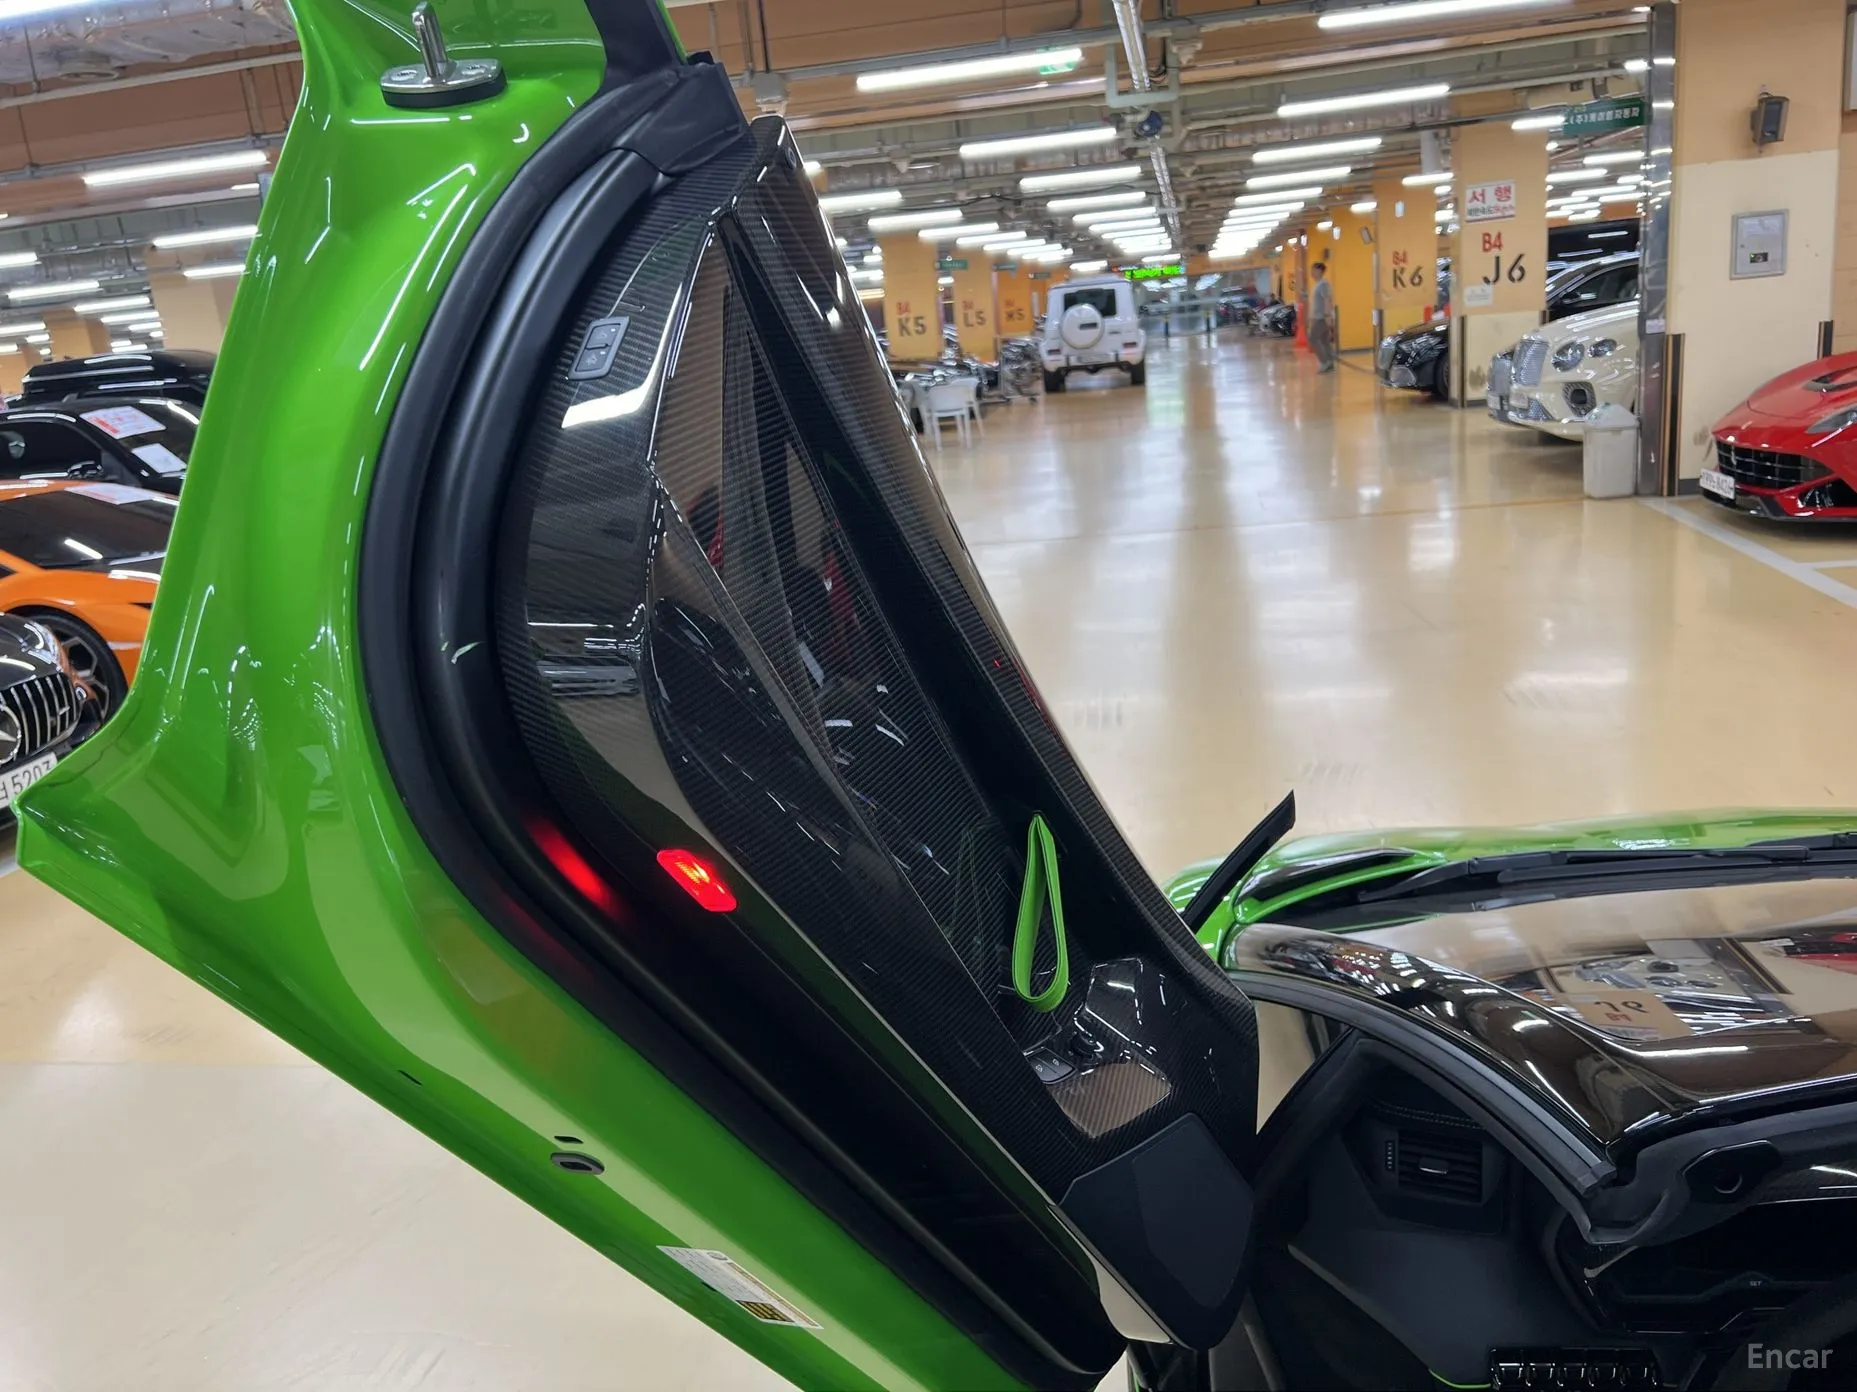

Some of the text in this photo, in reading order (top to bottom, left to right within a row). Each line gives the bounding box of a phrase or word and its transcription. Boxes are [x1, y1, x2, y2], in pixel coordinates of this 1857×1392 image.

[1482, 231, 1504, 253] B4
[1392, 250, 1408, 266] B4
[1393, 266, 1424, 289] K6
[1482, 253, 1526, 285] J6
[898, 316, 927, 337] K5
[963, 310, 986, 328] L5
